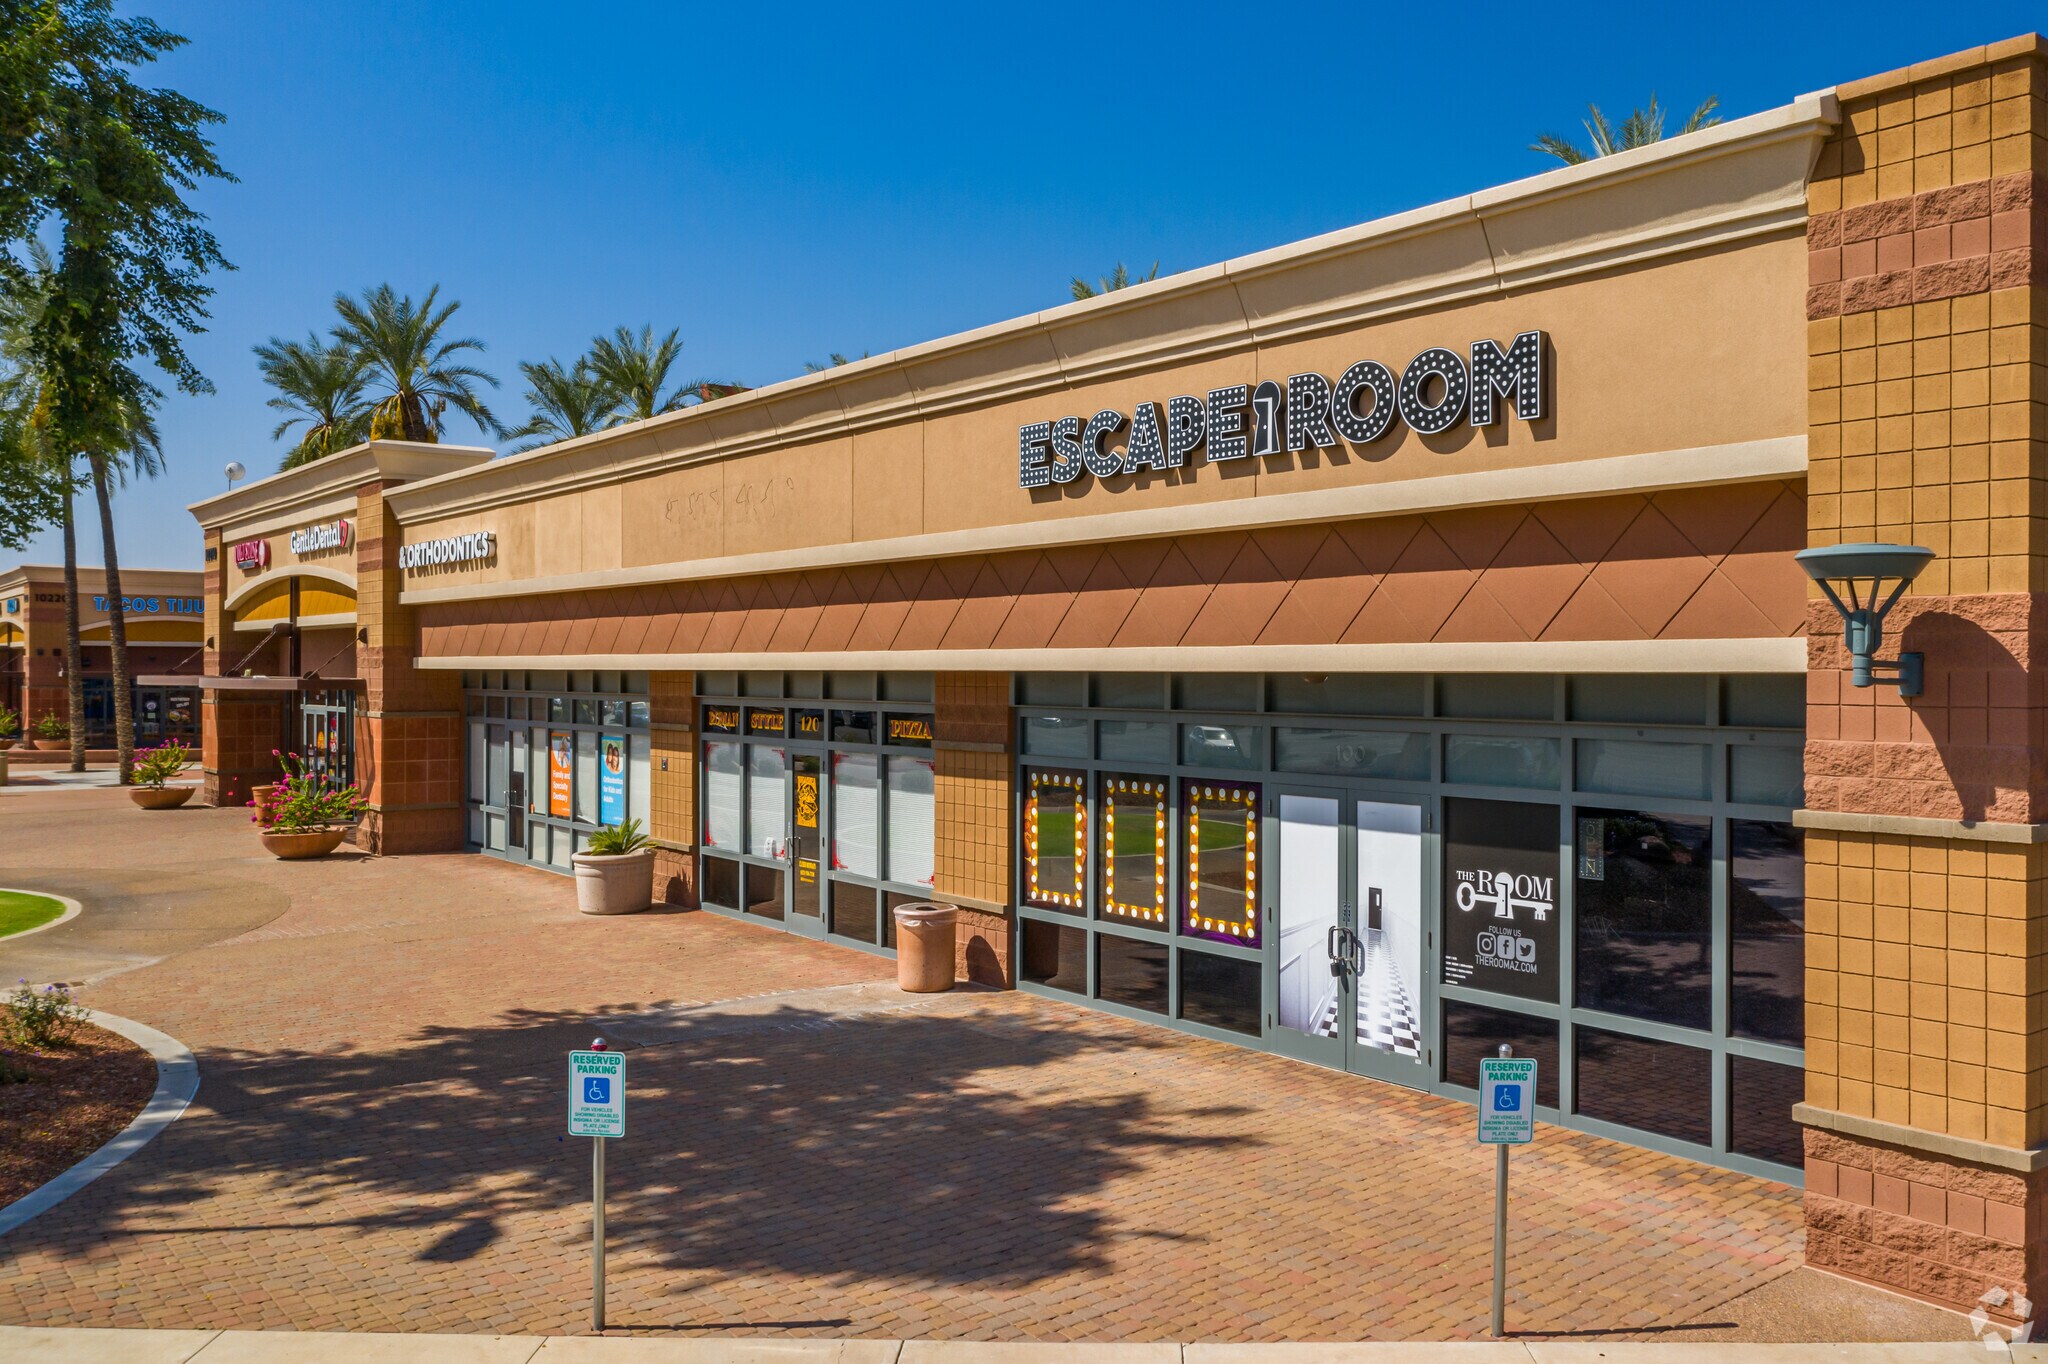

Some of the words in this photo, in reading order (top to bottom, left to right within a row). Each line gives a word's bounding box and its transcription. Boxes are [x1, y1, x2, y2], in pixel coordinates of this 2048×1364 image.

[1019, 384, 1249, 490] ESCAPE
[1287, 330, 1545, 452] ROOM
[290, 519, 340, 554] GentleDental
[399, 546, 406, 569] &
[407, 531, 488, 568] ORTHODONTICS
[751, 713, 784, 731] STYLE
[800, 716, 820, 732] 120
[890, 720, 933, 739] PIZZA
[1335, 744, 1365, 762] 100
[1456, 870, 1475, 881] THE
[1488, 925, 1512, 935] FOLLOW
[1513, 929, 1522, 937] US
[1475, 954, 1537, 974] THEROOMAZ.COM
[573, 1055, 621, 1065] RESERVED
[1485, 1063, 1532, 1072] RESERVED
[577, 1065, 617, 1075] PARKING
[1488, 1072, 1528, 1081] PARKING
